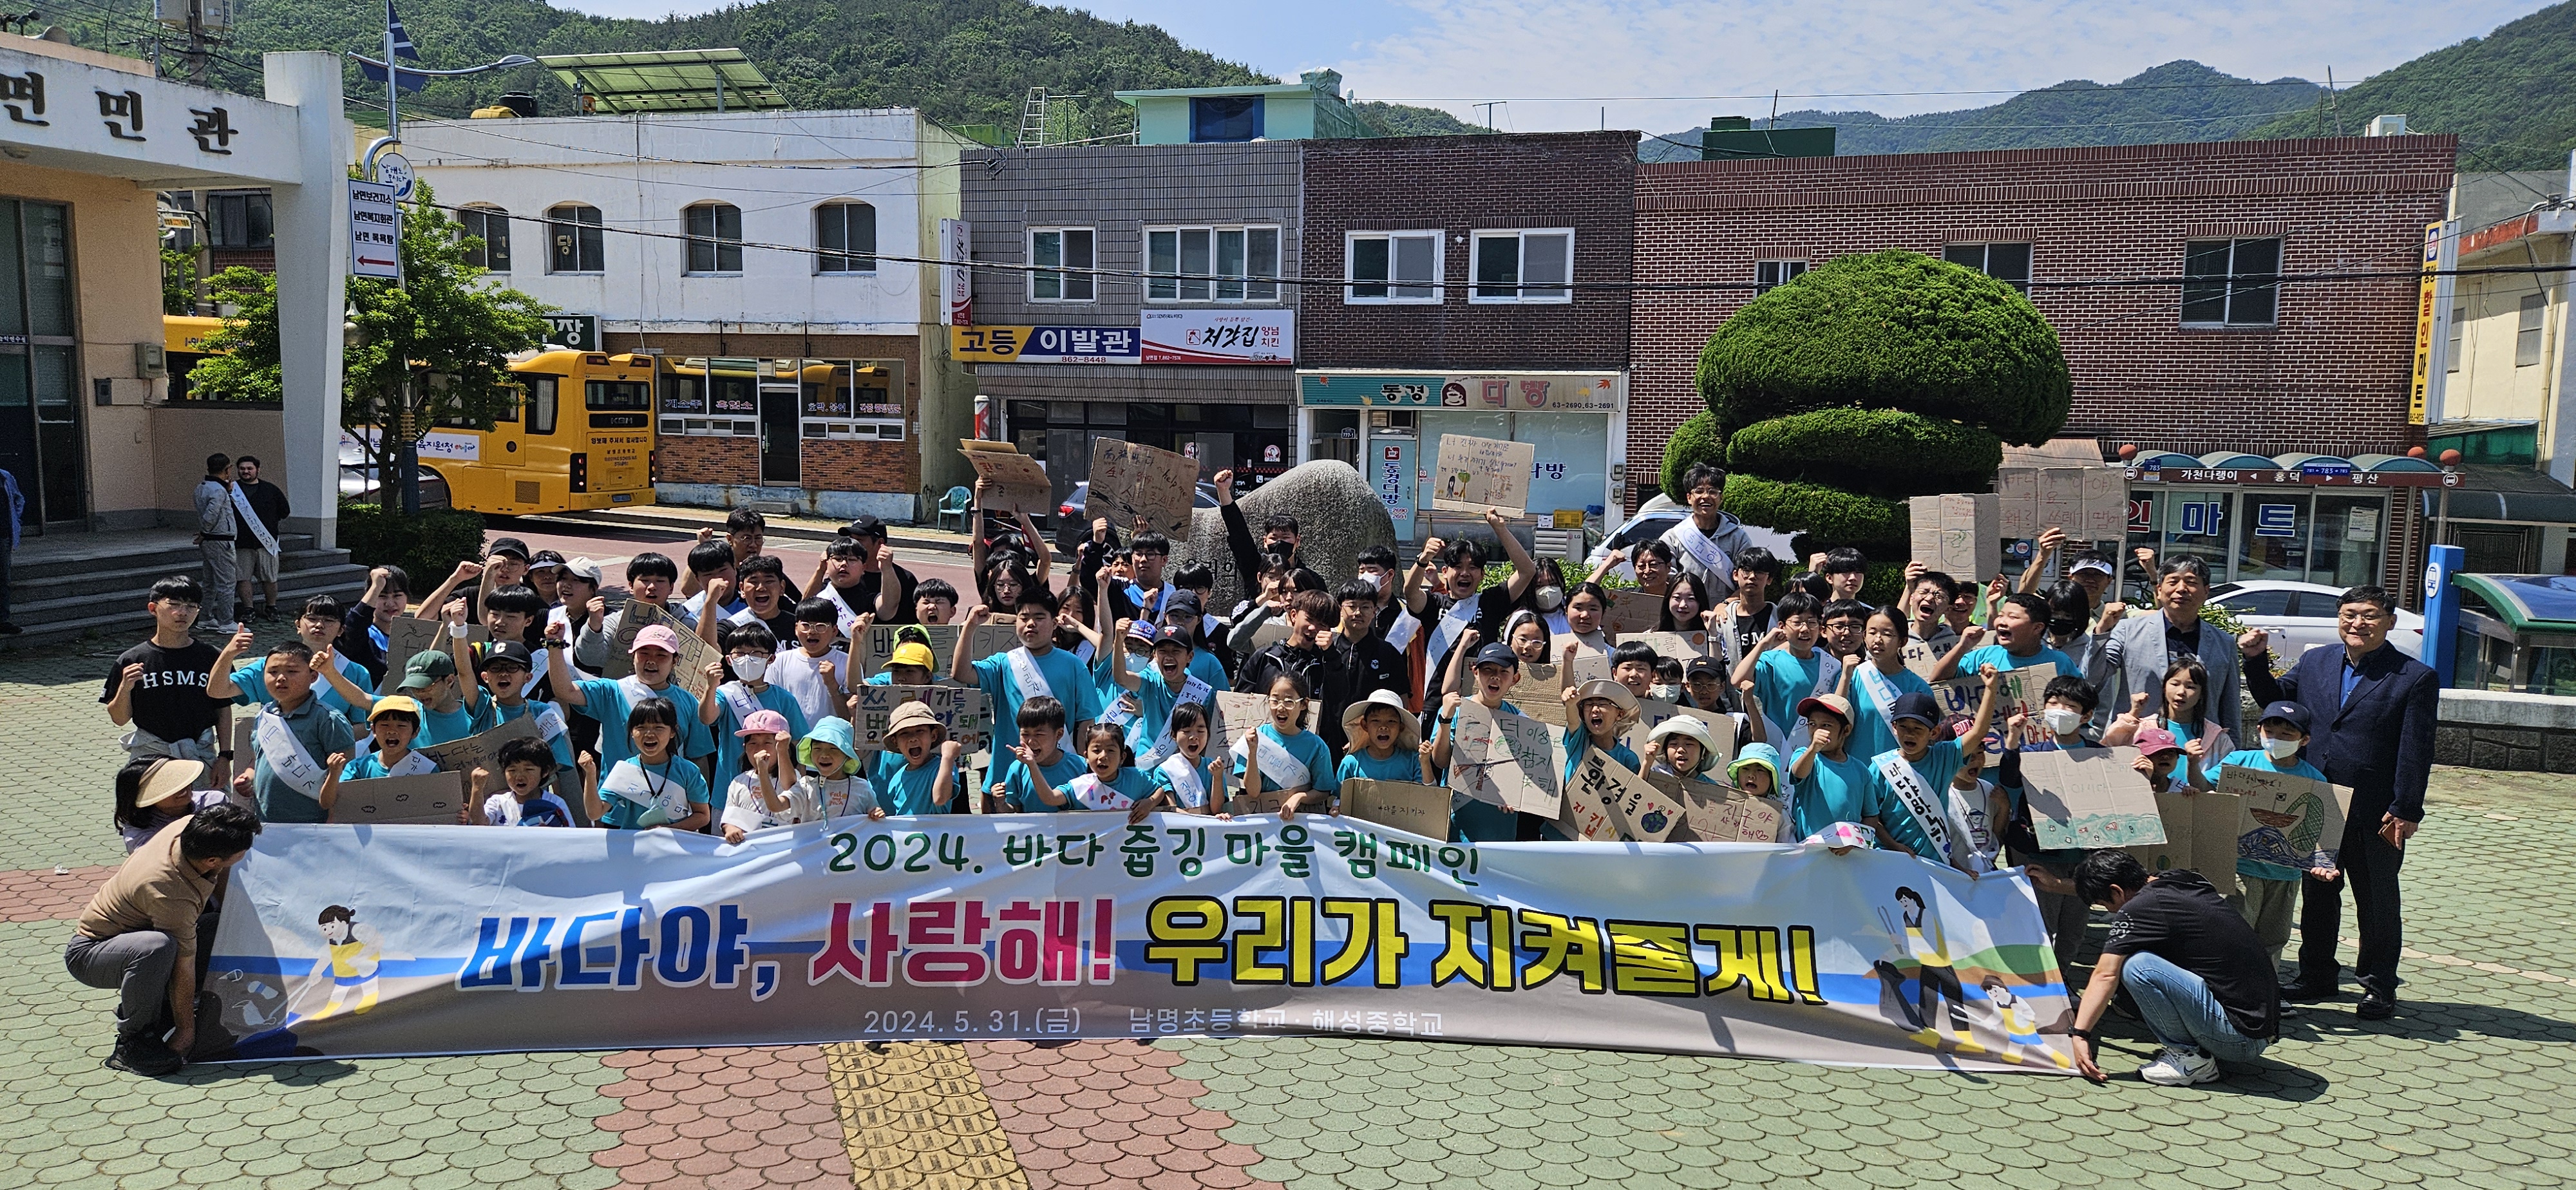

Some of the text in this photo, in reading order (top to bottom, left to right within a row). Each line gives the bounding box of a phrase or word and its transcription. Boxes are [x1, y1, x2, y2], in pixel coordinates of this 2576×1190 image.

[352, 189, 393, 205] 남면보건지소
[354, 210, 393, 225] 남면복지회관
[355, 231, 394, 245] 남면 목욕탕
[2424, 265, 2436, 283] 중앙
[1202, 325, 1259, 348] 처갓집
[1261, 326, 1280, 336] 양념
[959, 330, 1132, 355] 고등 이발관
[1261, 337, 1280, 348] 치킨
[2414, 289, 2432, 408] 할인마트
[1380, 380, 1550, 408] 동경 다방
[665, 399, 703, 409] 개소주
[715, 399, 754, 410] 흑염소
[1382, 462, 1401, 505] 동경다방
[2181, 469, 2238, 481] 가천다랭이
[2351, 473, 2379, 484] 평산
[494, 642, 507, 654] C
[142, 670, 209, 689] HSMS
[1500, 719, 1519, 738] 더
[1521, 746, 1552, 773] 참지
[829, 824, 1481, 887] 2024. 바다 줍깅 마을 캠페인
[456, 896, 1829, 1006] 바다야, 사랑해! 우리가 지켜줄게!
